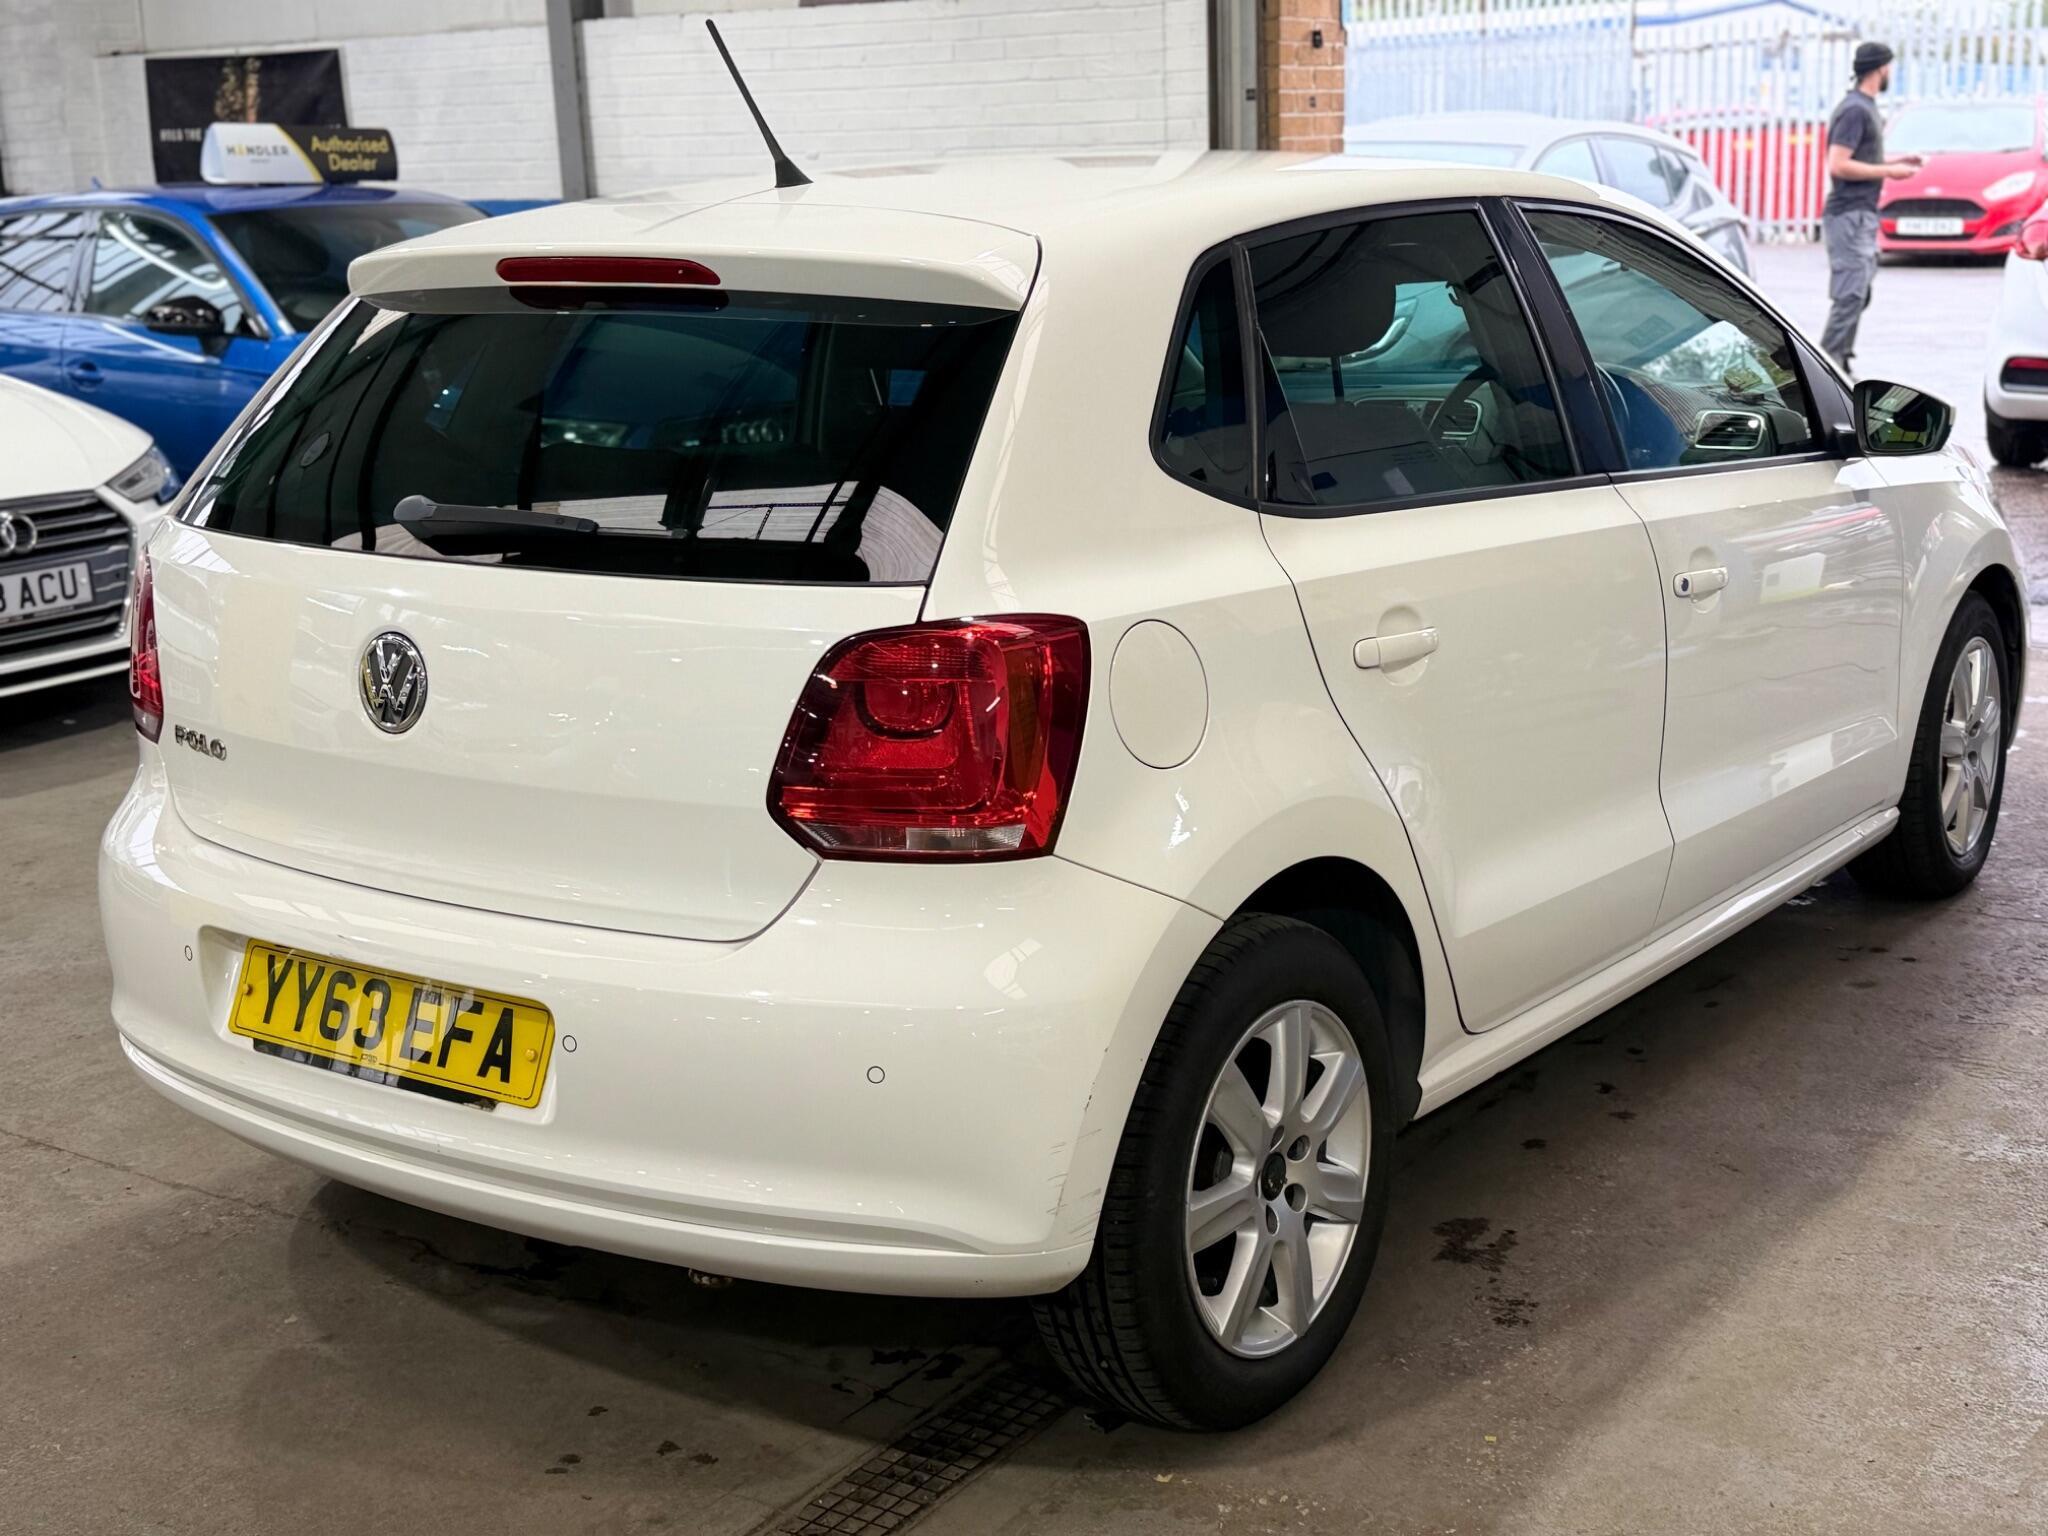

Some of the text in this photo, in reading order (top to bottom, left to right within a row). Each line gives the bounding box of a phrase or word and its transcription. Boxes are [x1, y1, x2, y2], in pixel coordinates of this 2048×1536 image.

[311, 135, 389, 153] Authorised
[328, 153, 378, 172] Dealer
[20, 568, 78, 609] ACU
[175, 724, 228, 761] POLO
[263, 954, 514, 1083] YY63 EFA
